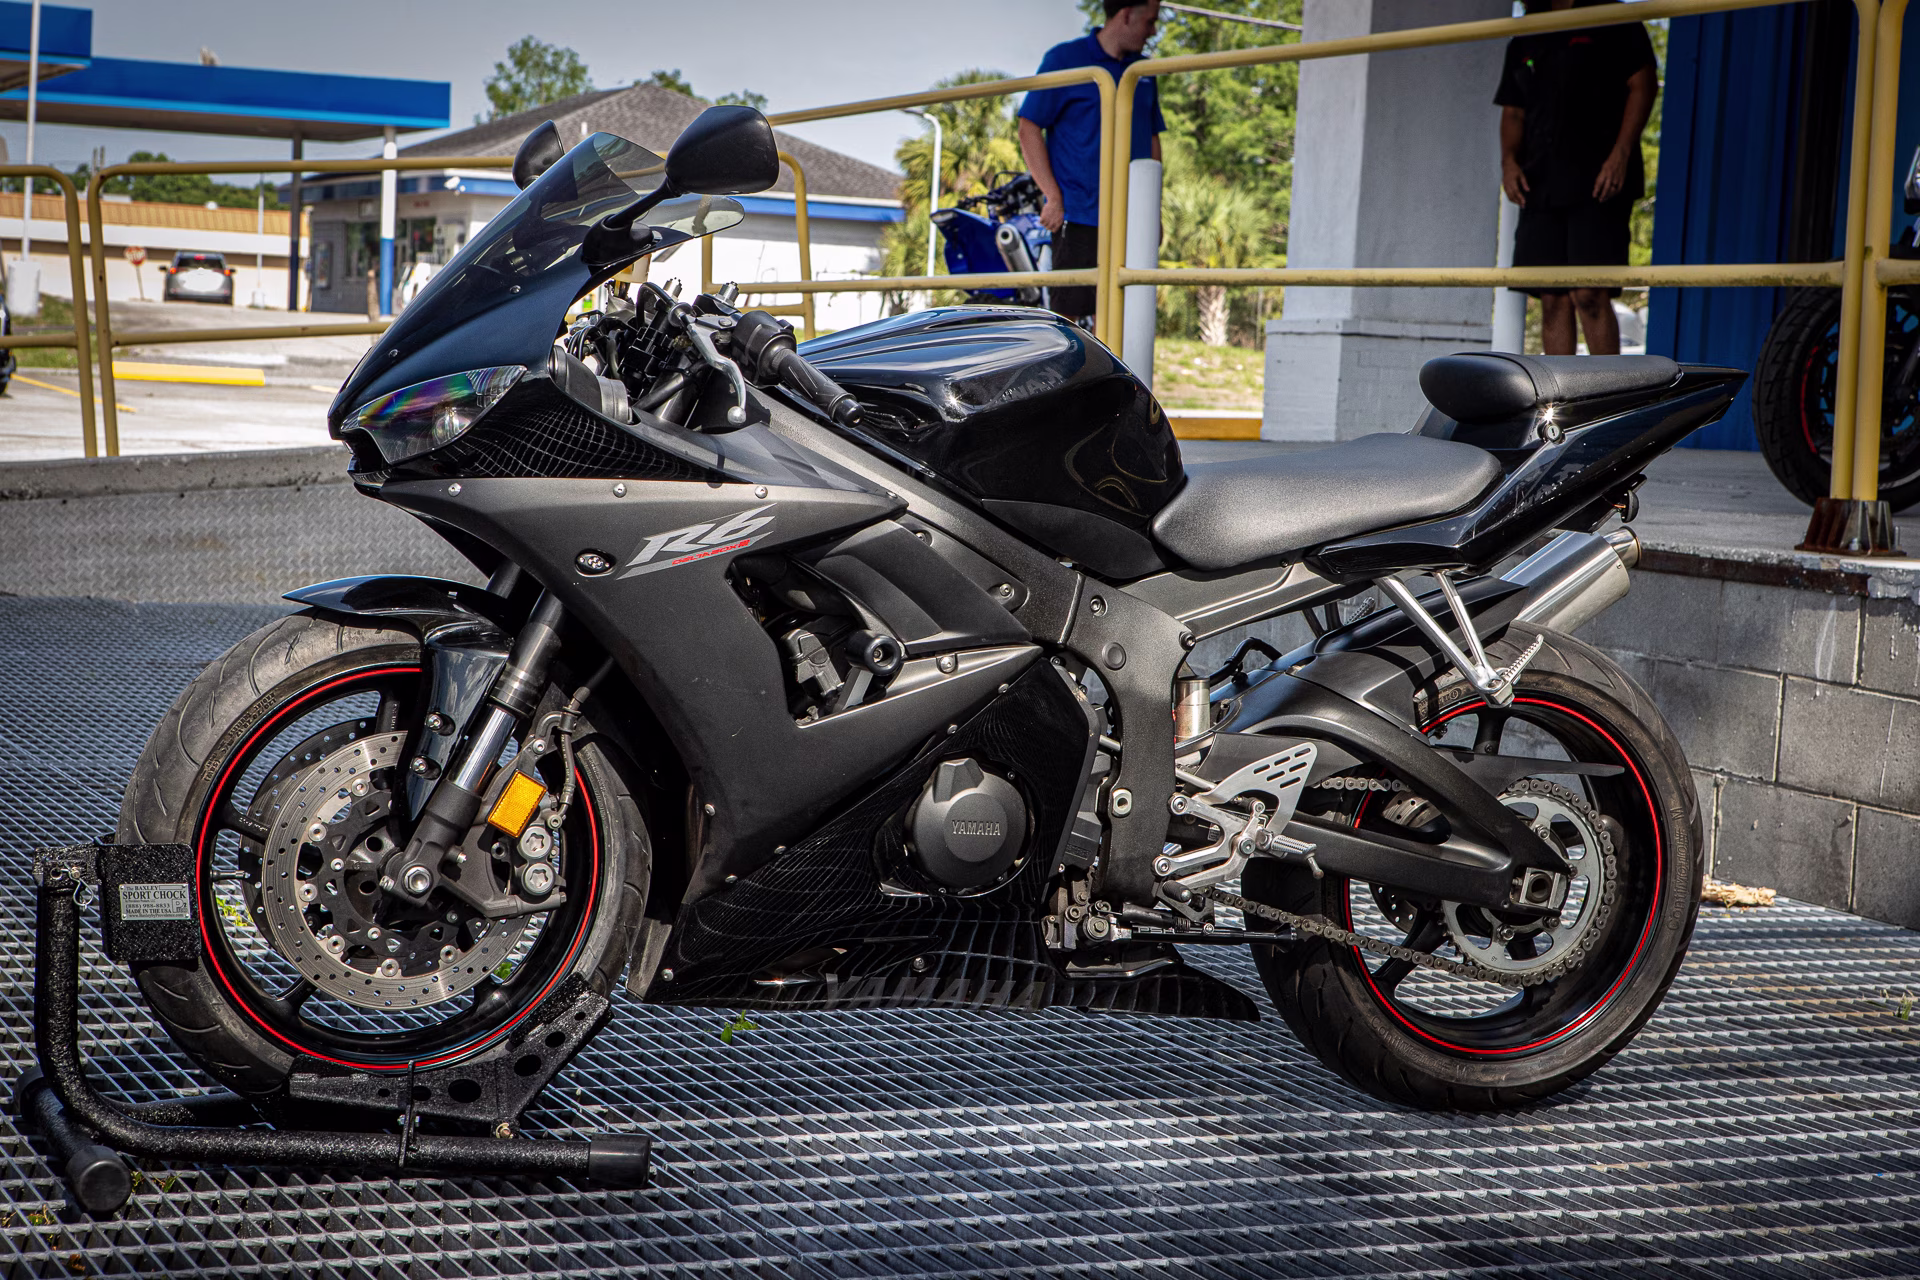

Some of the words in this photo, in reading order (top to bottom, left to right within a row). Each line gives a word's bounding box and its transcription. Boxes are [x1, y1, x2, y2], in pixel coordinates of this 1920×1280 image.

[625, 502, 778, 567] R6
[952, 819, 1001, 836] YAMAHA
[122, 890, 151, 899] SPORT
[153, 890, 186, 899] CHOCK
[824, 973, 1046, 1012] YAMAHA
